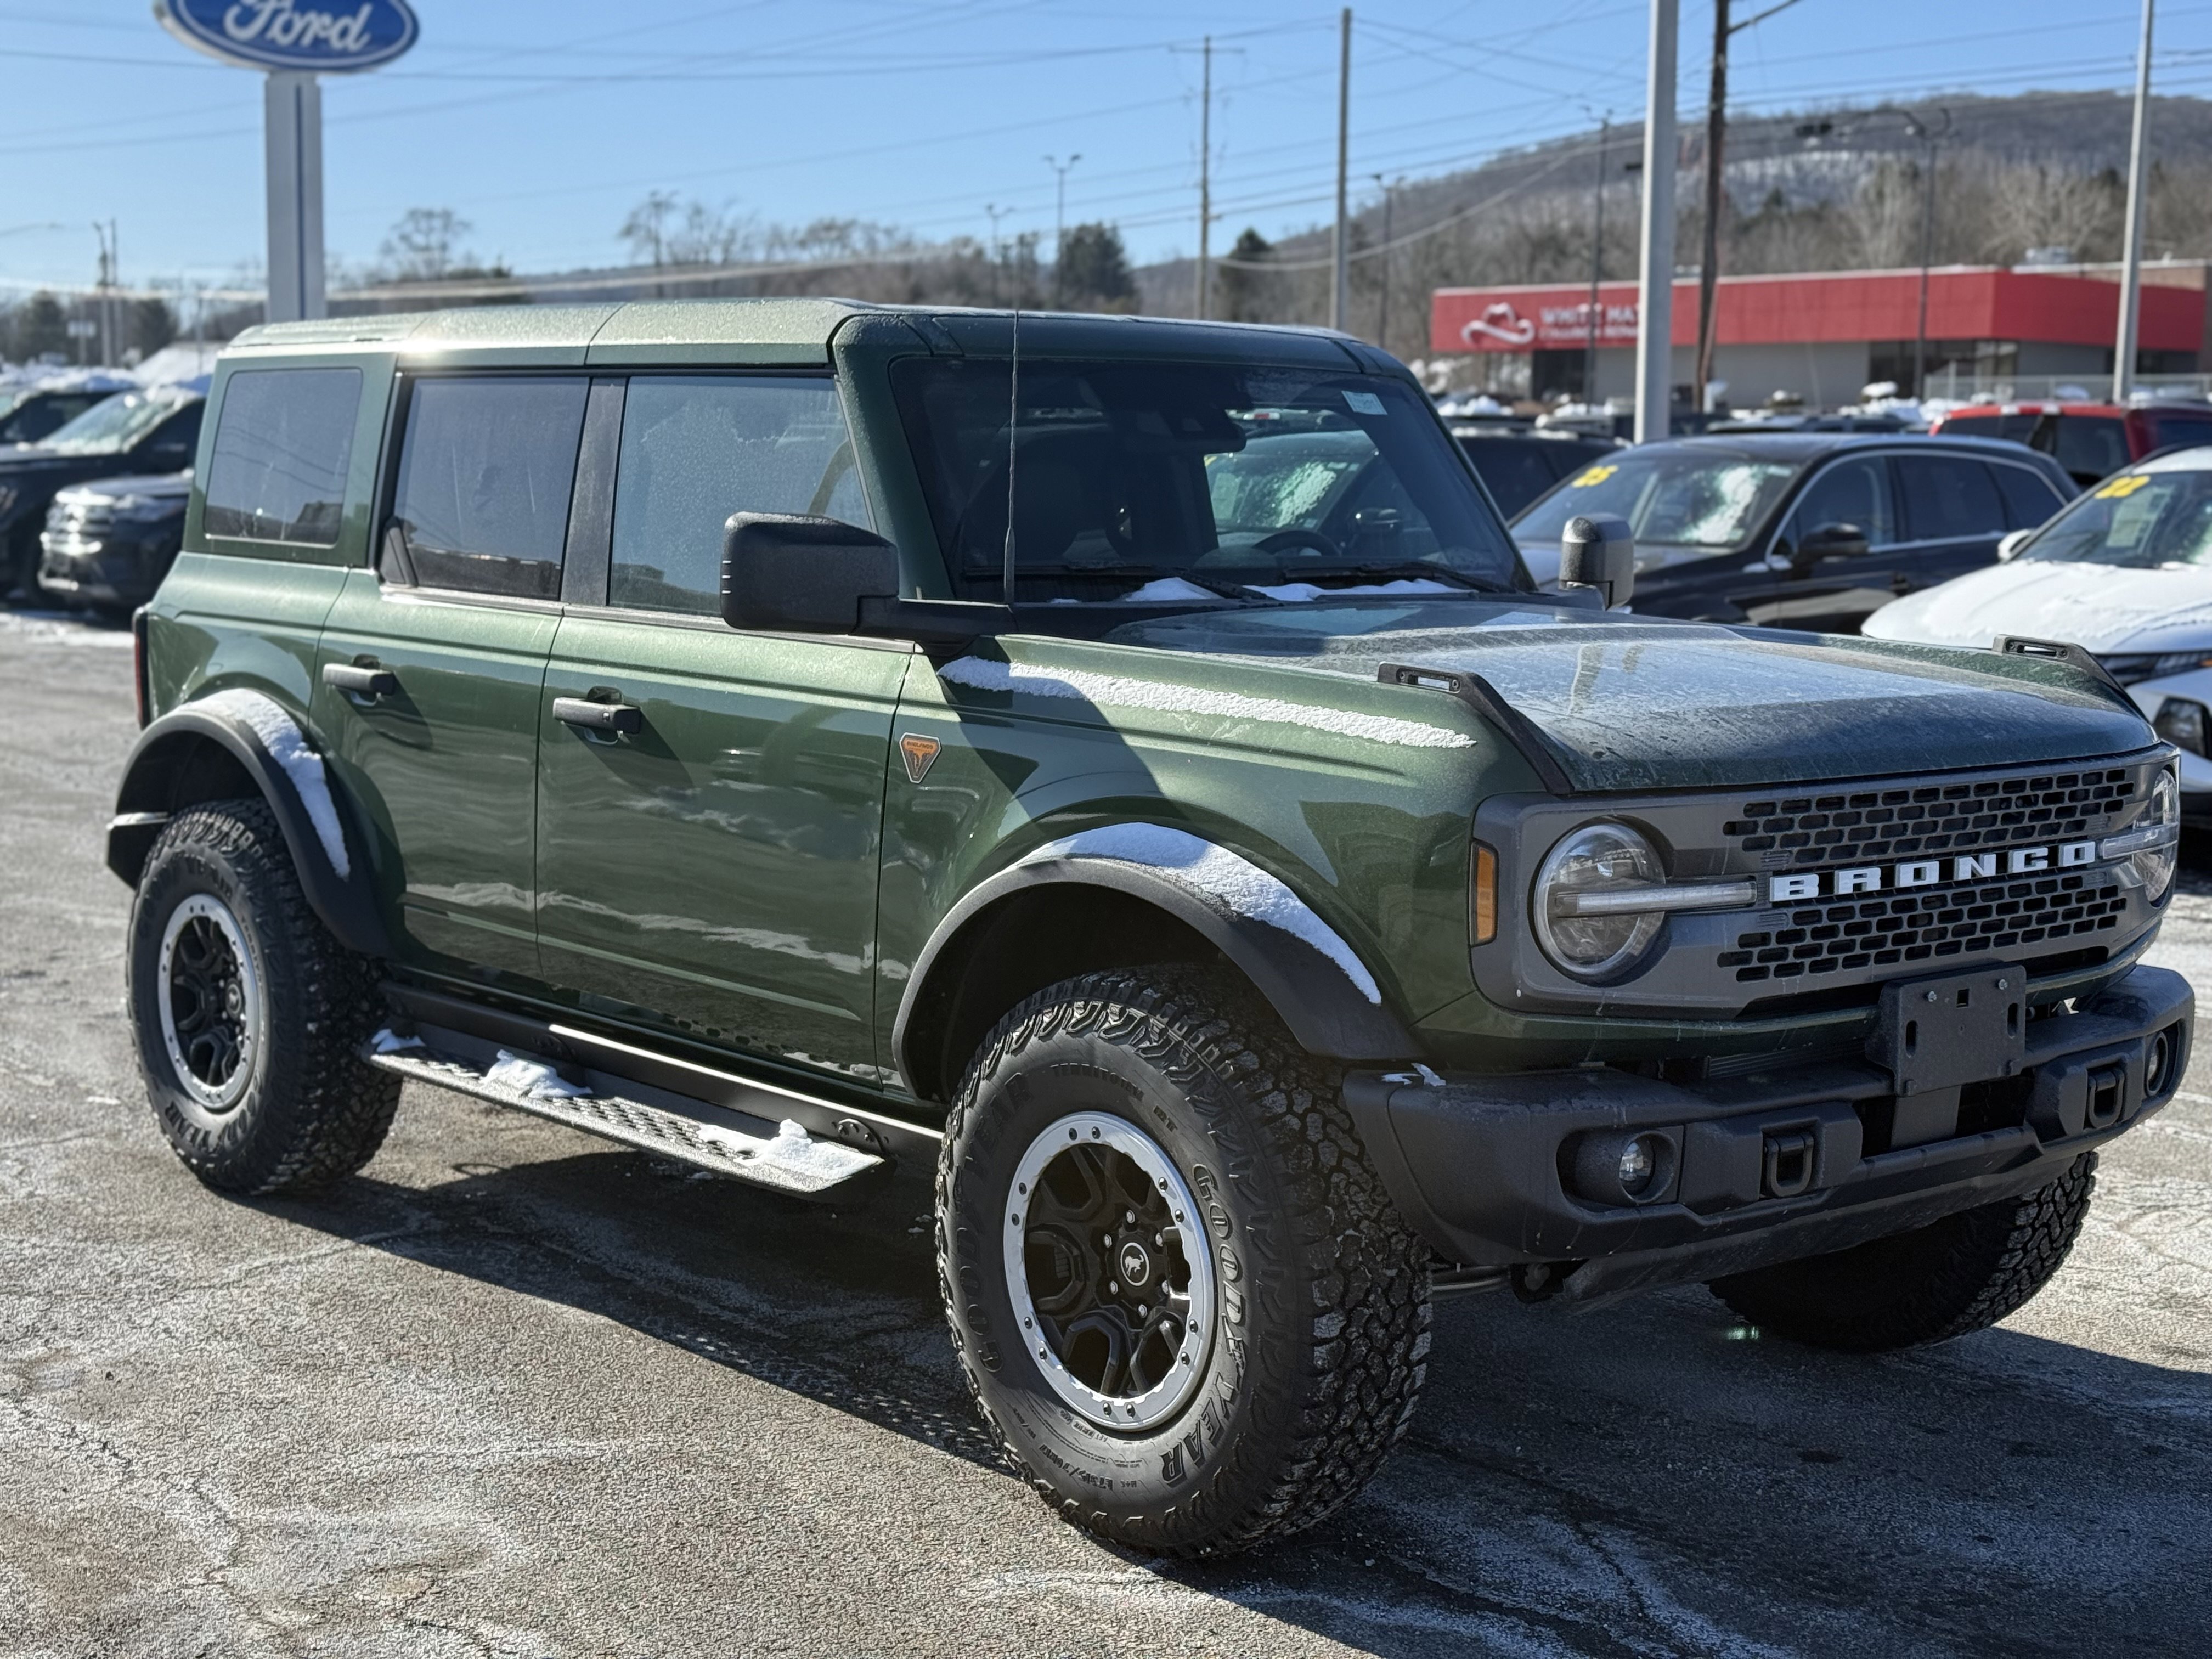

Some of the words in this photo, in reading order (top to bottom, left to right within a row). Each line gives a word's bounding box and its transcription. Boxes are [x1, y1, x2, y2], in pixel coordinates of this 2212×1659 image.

[224, 0, 373, 52] Ford
[1769, 840, 2096, 902] BRONCO
[1159, 1163, 1245, 1485] GOODYEAR
